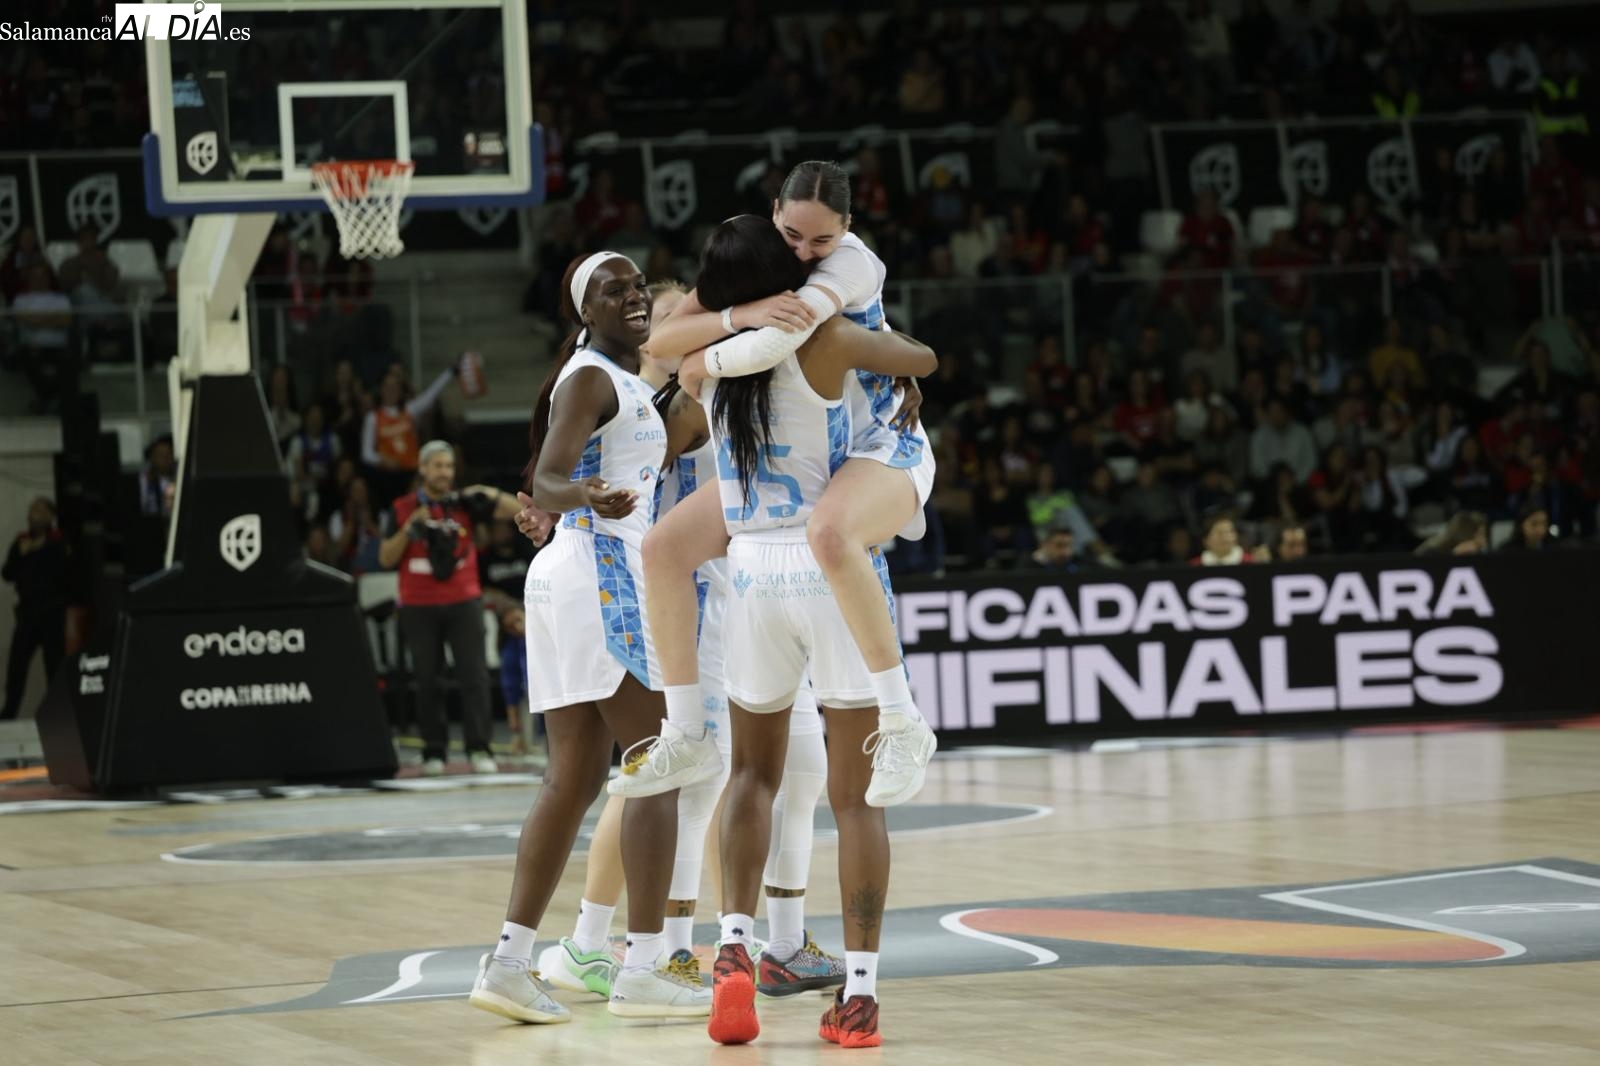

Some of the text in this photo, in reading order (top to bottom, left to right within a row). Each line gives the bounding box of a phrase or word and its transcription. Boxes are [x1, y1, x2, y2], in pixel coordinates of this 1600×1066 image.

[1272, 567, 1494, 627] PARA
[184, 625, 306, 658] endesa
[180, 687, 238, 710] COPA
[250, 682, 312, 706] REINA
